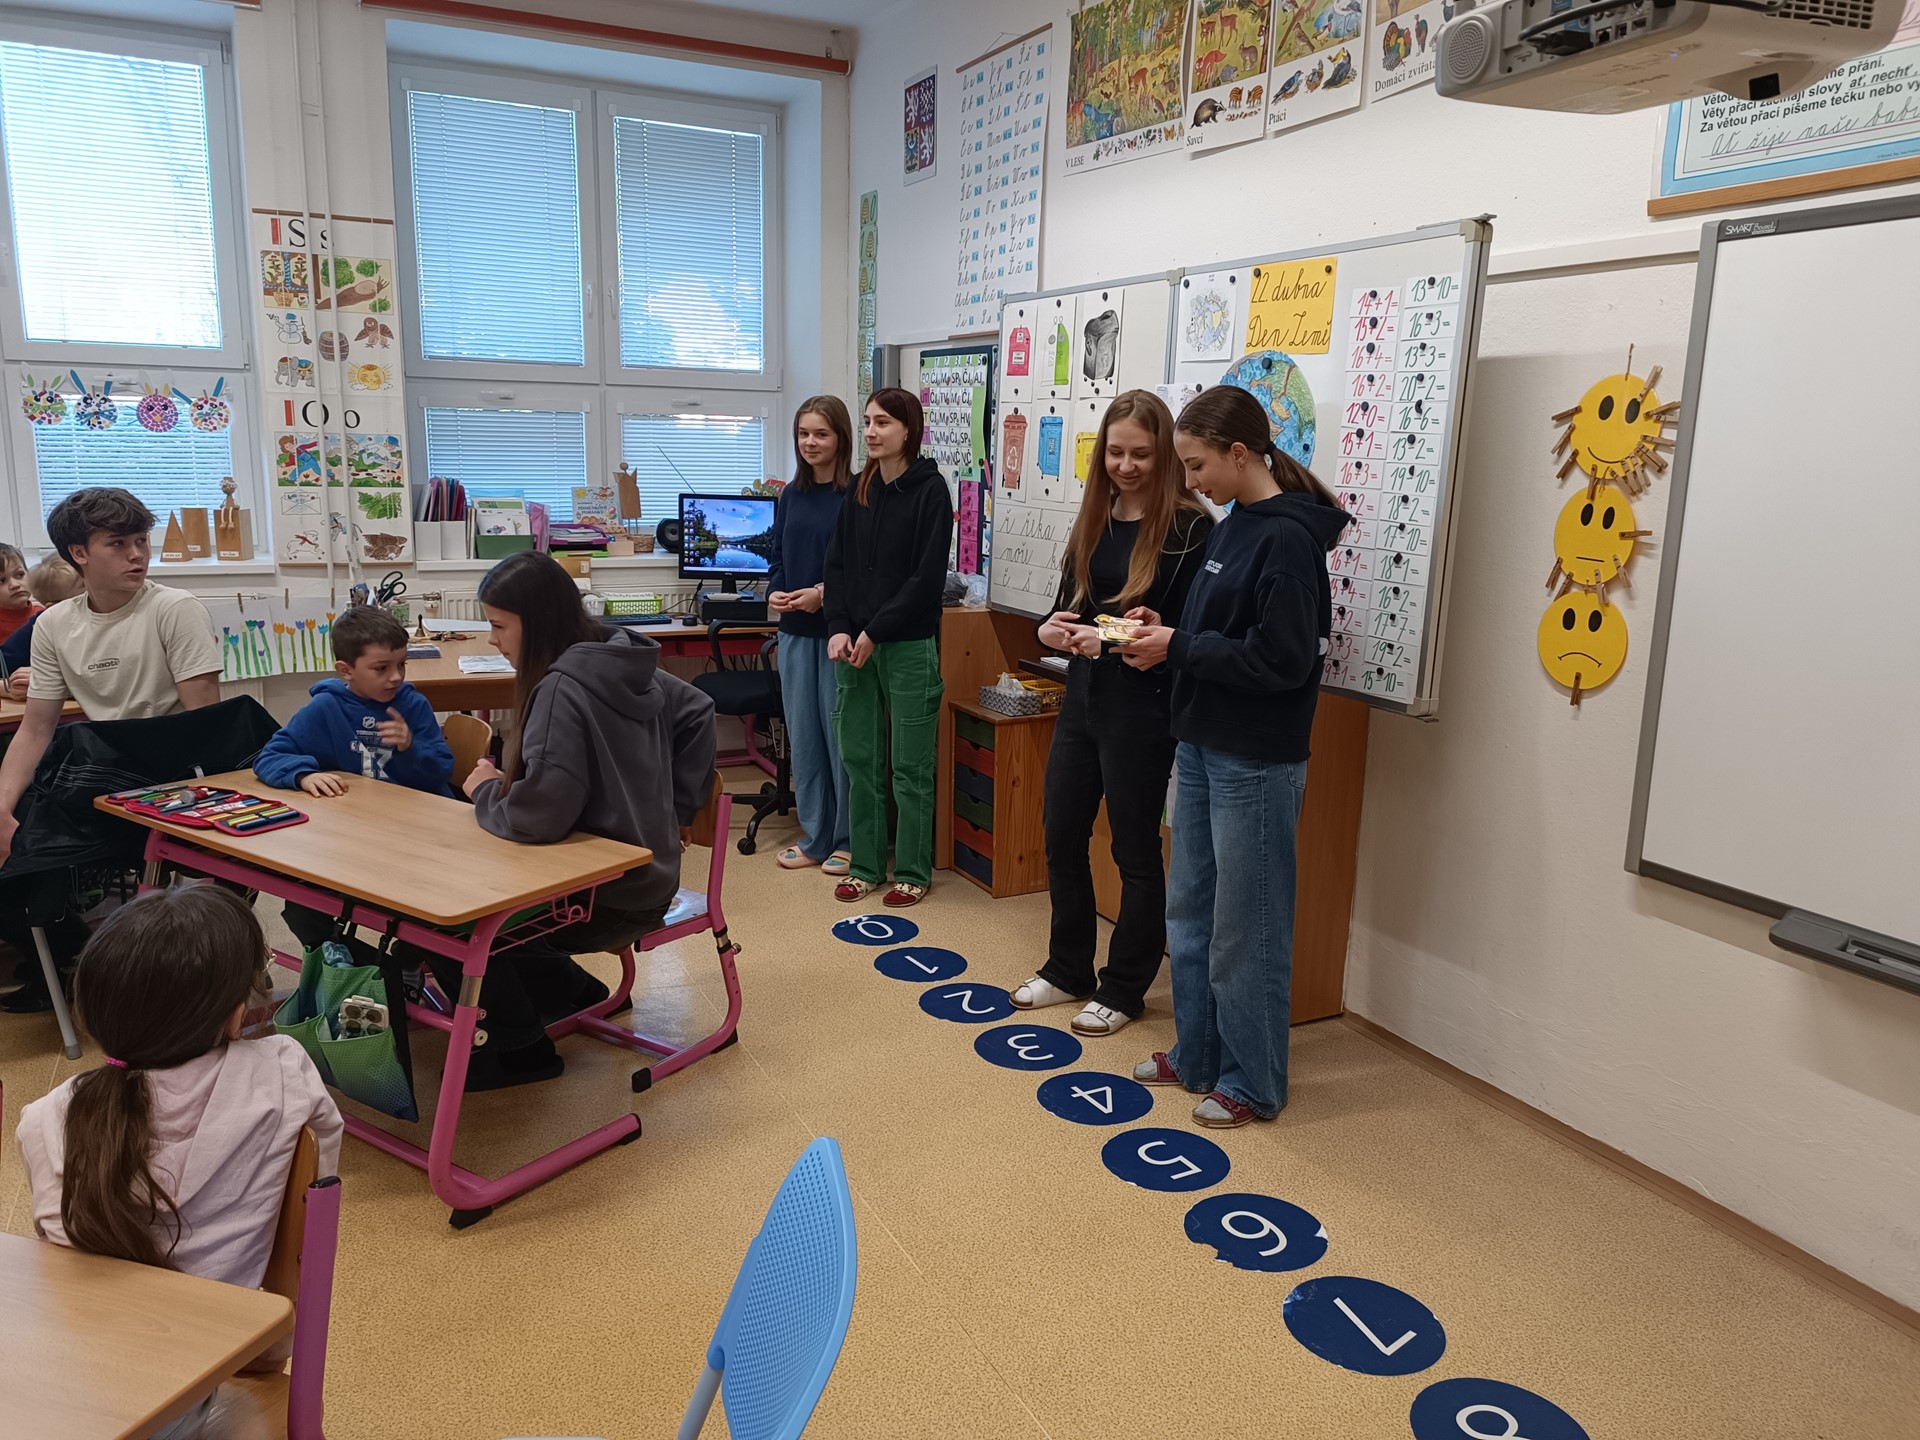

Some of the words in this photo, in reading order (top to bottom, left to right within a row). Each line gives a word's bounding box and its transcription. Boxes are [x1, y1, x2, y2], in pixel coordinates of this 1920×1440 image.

[1375, 68, 1406, 92] Domácí
[1408, 62, 1436, 79] zvířata
[1848, 56, 1885, 77] přání.
[1700, 122, 1714, 133] Za
[1717, 116, 1747, 129] větou
[1750, 106, 1780, 125] přací
[1783, 99, 1826, 118] píšeme
[1831, 91, 1865, 106] tečku
[1870, 83, 1902, 98] nebo
[1702, 107, 1726, 119] Věty
[1808, 82, 1842, 97] slovy
[1268, 108, 1287, 125] Ptáci
[1798, 115, 1860, 141] naše
[1186, 133, 1203, 147] Savci
[289, 219, 306, 248] S
[1725, 222, 1755, 235] SMART
[1271, 268, 1327, 302] dubna
[1246, 315, 1289, 348] Den
[1289, 311, 1332, 347] Země
[302, 401, 329, 427] O
[344, 410, 360, 428] o
[856, 920, 893, 939] 0
[904, 954, 939, 975] 1
[942, 989, 995, 1015] 2
[1006, 1033, 1054, 1061] 3
[1070, 1085, 1113, 1114] 4
[1137, 1140, 1202, 1180] 5
[1333, 1296, 1417, 1356] 7
